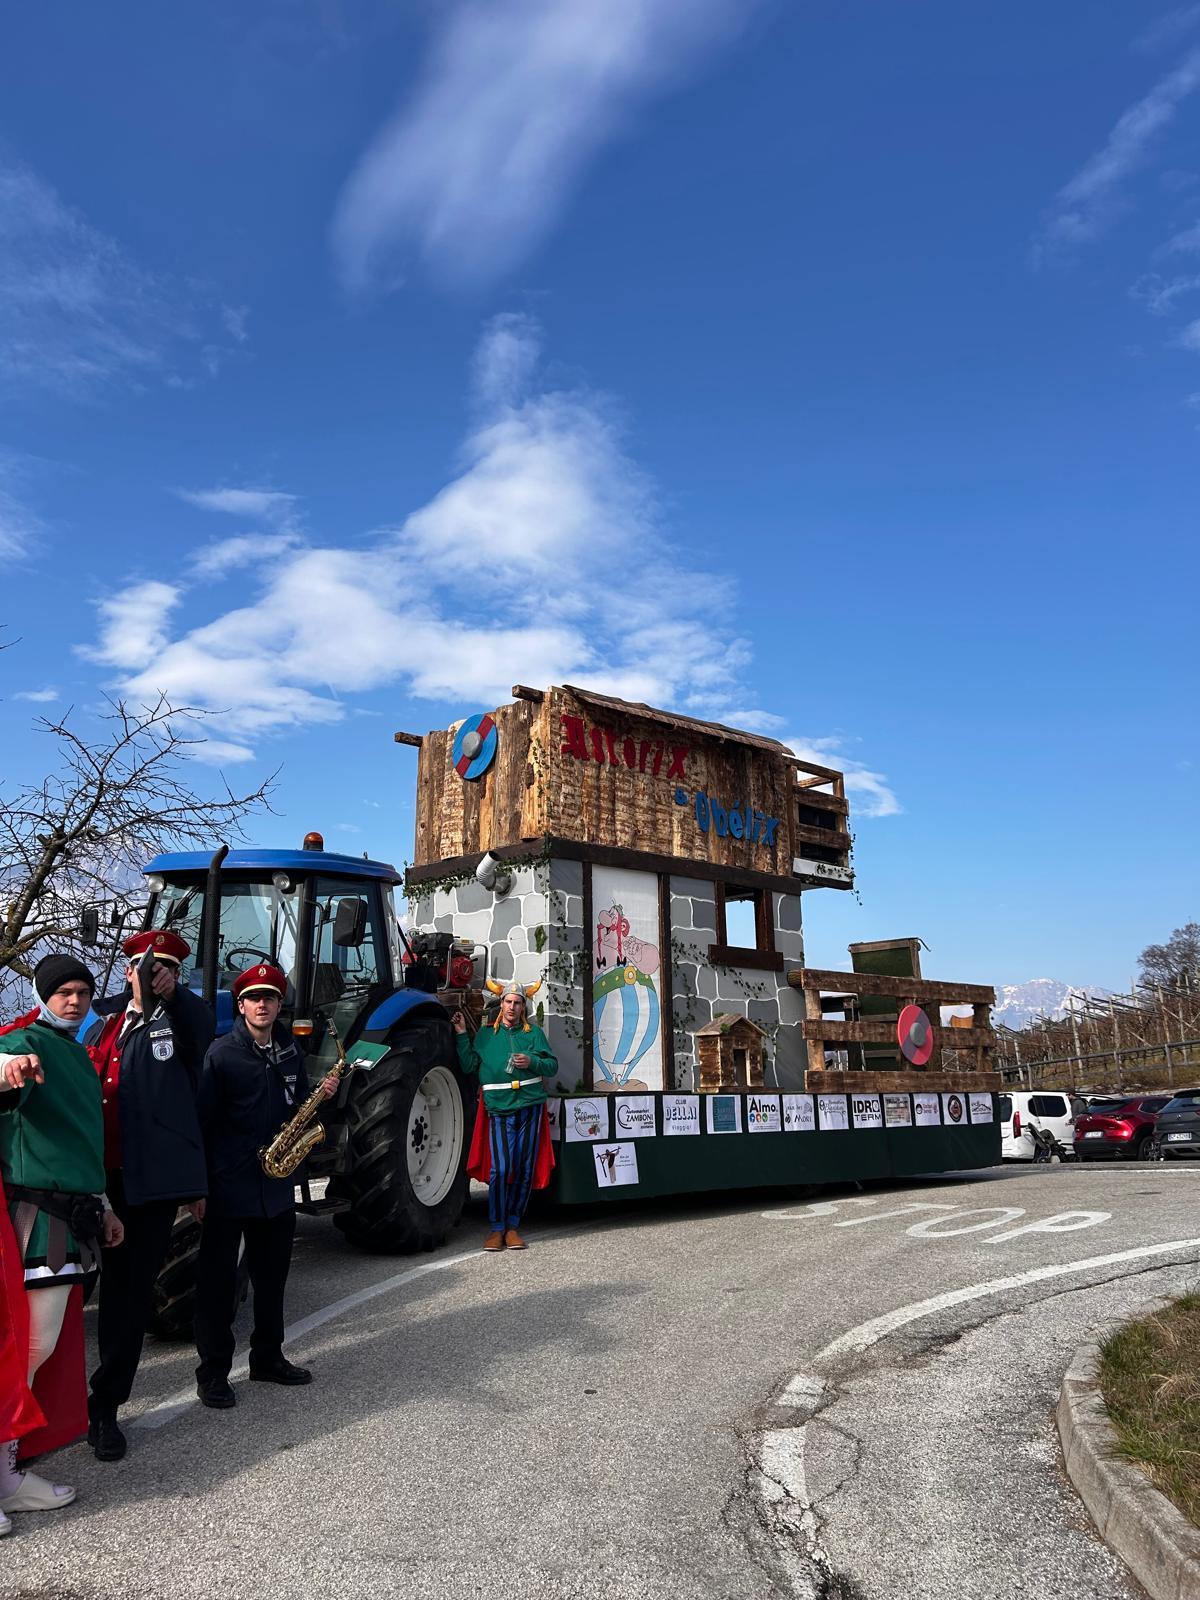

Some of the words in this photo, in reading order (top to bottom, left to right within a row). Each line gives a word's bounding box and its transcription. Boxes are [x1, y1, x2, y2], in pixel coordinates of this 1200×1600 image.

[853, 1100, 880, 1113] IDRO
[626, 1114, 654, 1122] ZAMBONI
[854, 1113, 882, 1121] TERM
[760, 1198, 1112, 1244] STOP
